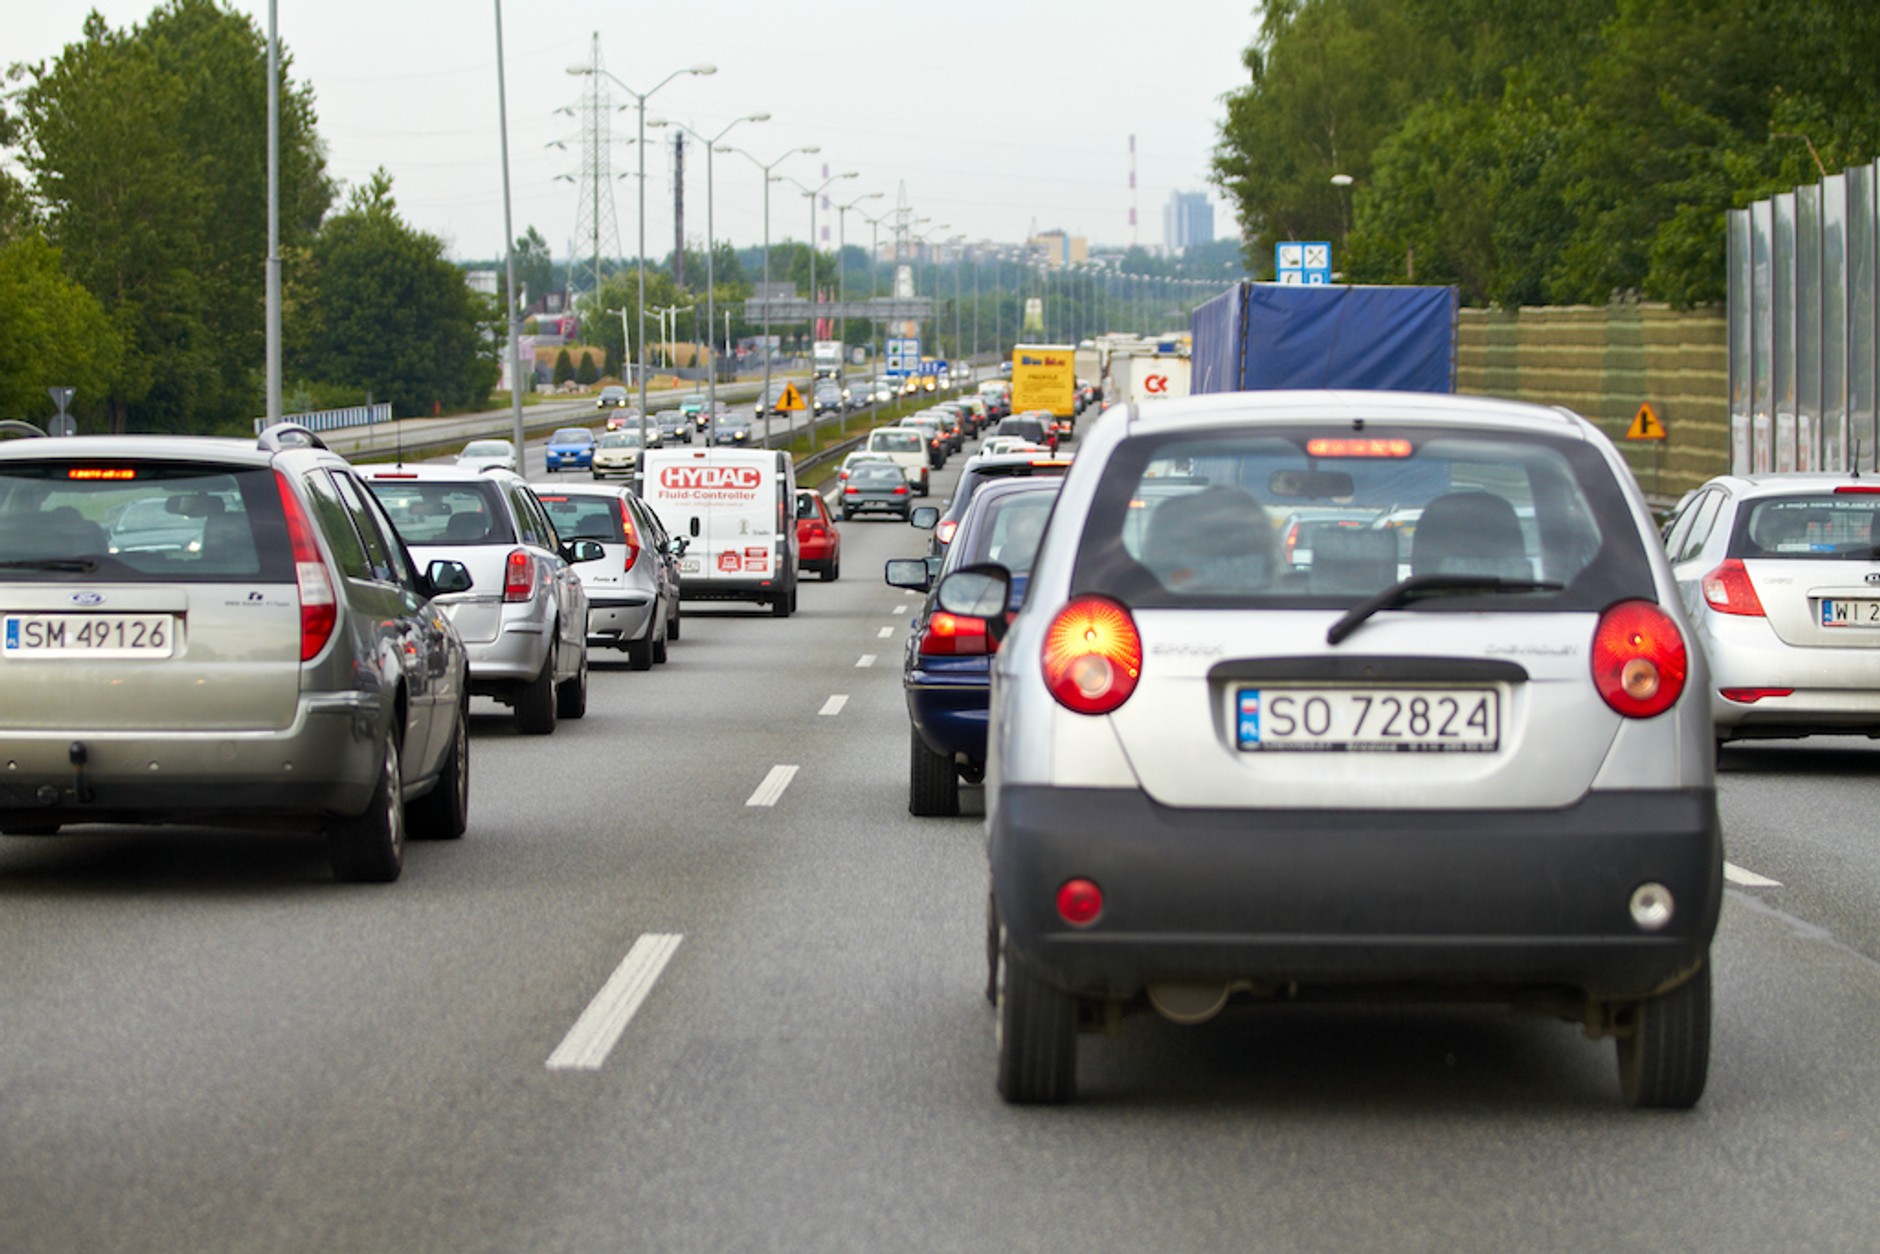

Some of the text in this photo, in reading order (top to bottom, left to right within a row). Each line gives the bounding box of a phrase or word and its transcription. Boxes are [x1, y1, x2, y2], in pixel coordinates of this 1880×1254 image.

[665, 467, 759, 488] HYDAC
[658, 490, 756, 500] Fluid-Controller
[1835, 603, 1858, 621] WI
[25, 620, 166, 649] SM 49126
[1269, 695, 1488, 737] SO 72824
